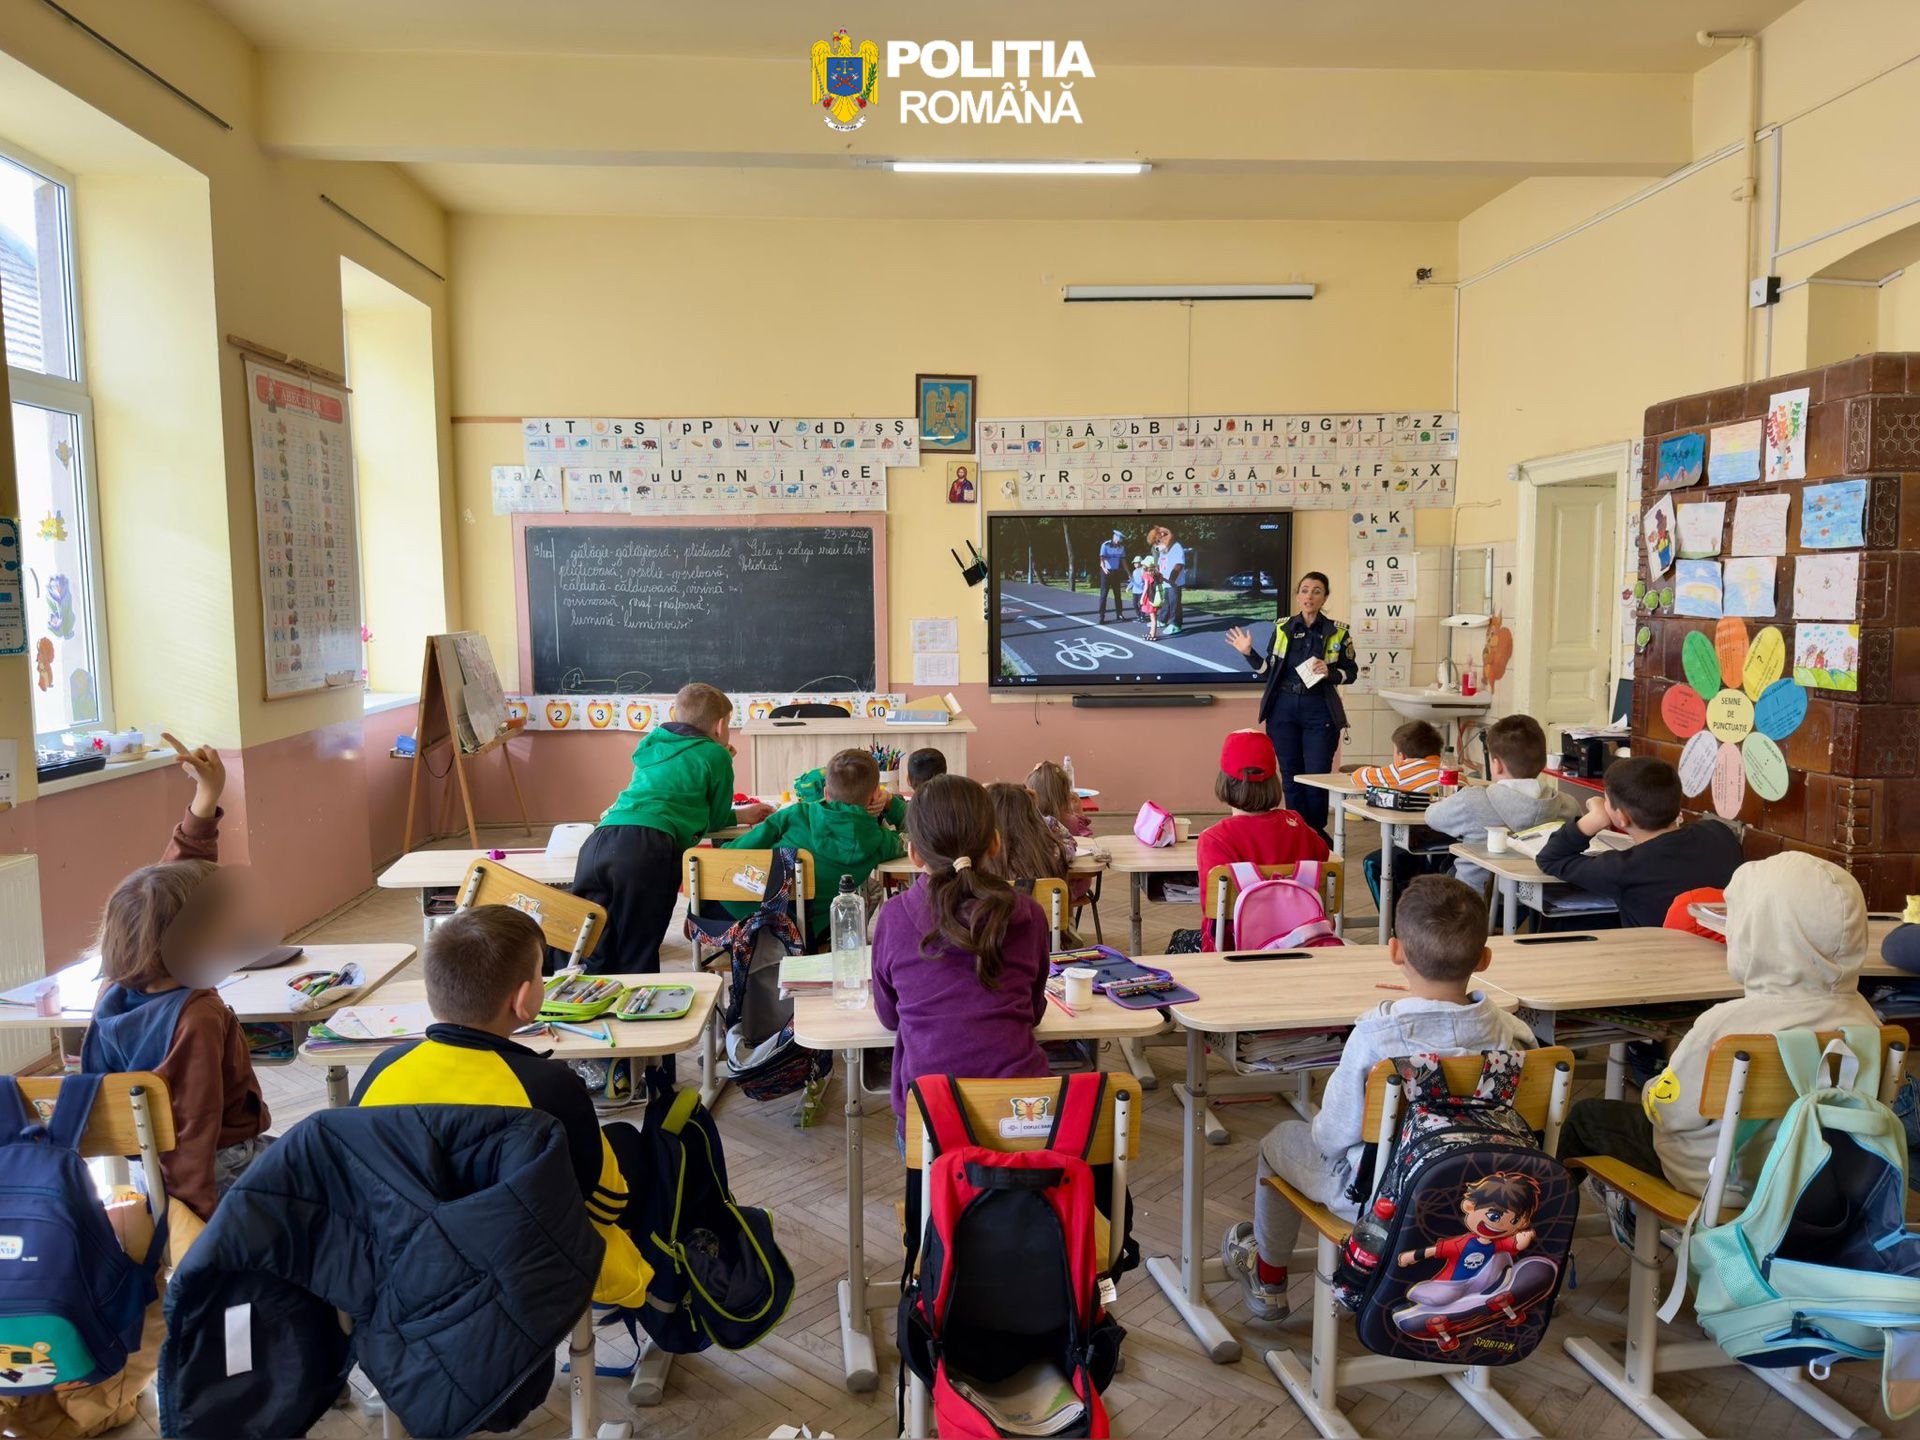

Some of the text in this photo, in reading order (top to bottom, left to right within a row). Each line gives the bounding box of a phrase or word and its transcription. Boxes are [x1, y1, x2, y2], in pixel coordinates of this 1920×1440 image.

[545, 420, 576, 434] t T
[614, 421, 645, 435] s S
[682, 420, 713, 436] p P
[750, 420, 780, 434] v V
[814, 421, 845, 434] d D
[1131, 421, 1160, 435] b B
[1194, 418, 1222, 435] j J
[1244, 418, 1273, 432] h H
[1301, 417, 1332, 433] g G
[1413, 414, 1443, 429] z Z
[513, 468, 547, 481] a A
[589, 470, 622, 483] m M
[651, 469, 682, 483] u U
[716, 469, 747, 482] n N
[841, 465, 871, 479] e E
[1039, 470, 1070, 483] r R
[1354, 464, 1383, 477] f F
[1410, 463, 1441, 477] x X
[1370, 510, 1400, 524] k K
[1366, 556, 1399, 571] q Q
[1365, 605, 1402, 617] w W
[1369, 651, 1399, 664] y Y
[512, 710, 518, 719] 1
[555, 710, 562, 721] 2
[596, 709, 605, 721] 3
[634, 712, 642, 723] 4
[757, 709, 765, 719] 7
[871, 706, 886, 717] 10
[1727, 710, 1735, 718] DE
